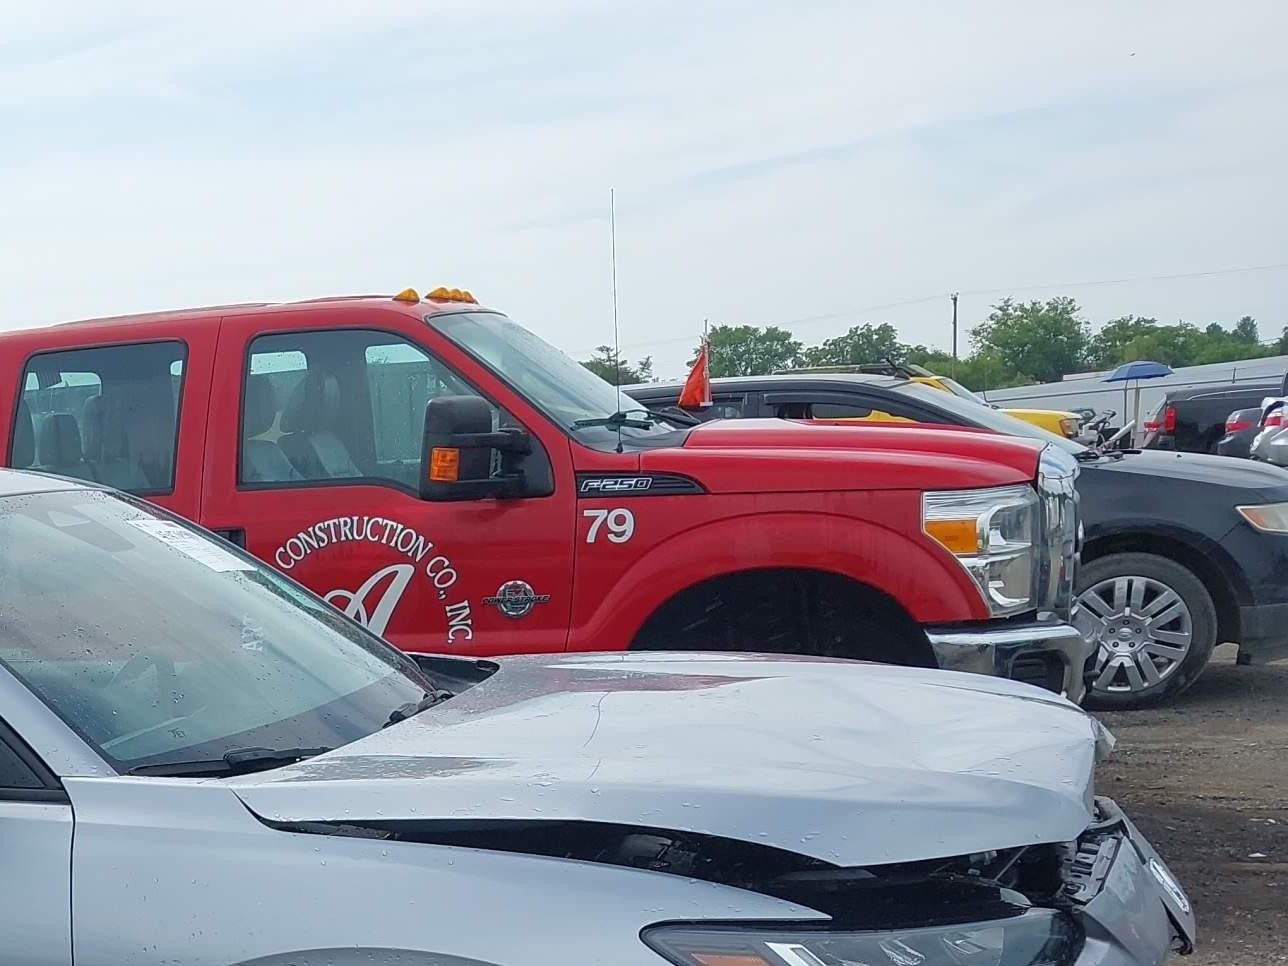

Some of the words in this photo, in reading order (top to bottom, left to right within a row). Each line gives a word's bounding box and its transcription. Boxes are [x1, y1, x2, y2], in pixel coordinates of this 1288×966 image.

[583, 508, 635, 544] 79
[275, 516, 434, 569] CONSTRUCTION
[445, 599, 473, 644] INC.
